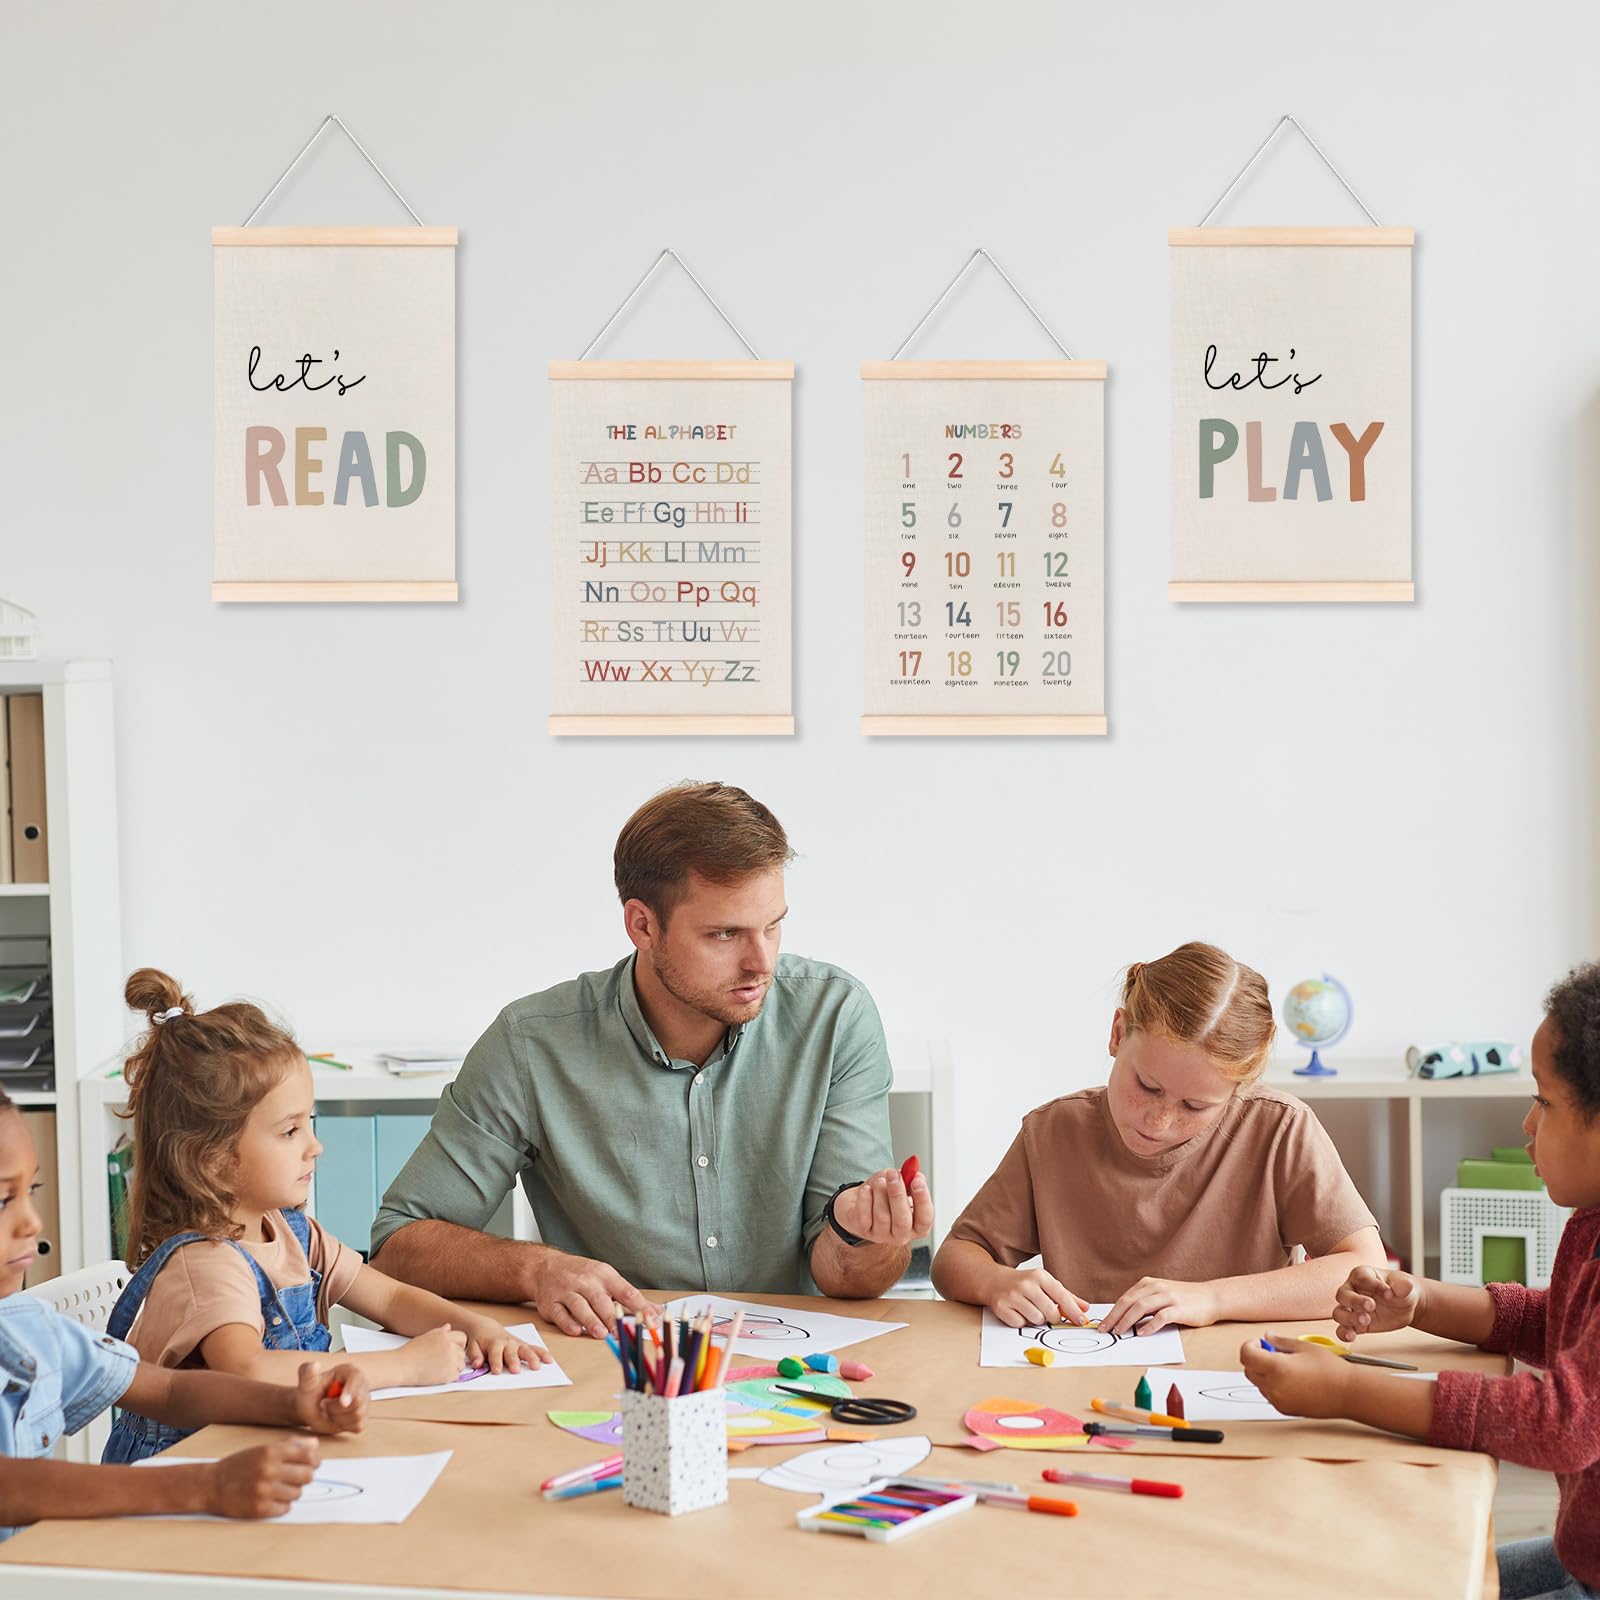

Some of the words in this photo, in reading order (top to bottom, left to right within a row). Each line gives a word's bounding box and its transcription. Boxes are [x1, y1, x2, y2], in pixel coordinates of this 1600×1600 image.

[248, 345, 366, 396] let's
[1204, 344, 1322, 395] let's
[606, 425, 637, 440] THE
[644, 425, 737, 440] ALPHABET
[945, 423, 1023, 439] NUMBERS
[245, 425, 427, 508] READ
[584, 462, 618, 483] Aa
[629, 462, 662, 483] Bb
[672, 462, 706, 483] Cc
[716, 462, 750, 483] Dd
[902, 453, 910, 479] 1
[948, 453, 963, 479] 2
[998, 453, 1014, 479] 3
[1049, 453, 1066, 479] 4
[1199, 418, 1385, 502] PLAY
[584, 502, 614, 523] Ee
[623, 502, 646, 523] Ff
[654, 501, 686, 528] Gg
[695, 502, 726, 523] Hh
[736, 502, 747, 523] Ii
[902, 502, 917, 528] 5
[947, 502, 962, 528] 6
[998, 502, 1013, 528] 7
[1051, 502, 1067, 528] 8
[1048, 531, 1068, 539] eight
[585, 541, 608, 568] Jj
[619, 541, 653, 562] Kk
[664, 541, 686, 562] Ll
[699, 541, 746, 562] Mm
[901, 552, 916, 577] 9
[944, 552, 971, 577] 10
[997, 552, 1016, 577] 11
[1043, 552, 1069, 577] 12
[586, 581, 619, 602] Nn
[630, 581, 667, 602] Oo
[677, 581, 710, 607] Pp
[720, 581, 756, 607] Qq
[897, 601, 922, 627] 13
[945, 601, 972, 627] 14
[996, 601, 1021, 627] 15
[1043, 601, 1068, 627] 16
[584, 621, 609, 642] Rr
[617, 621, 644, 642] Ss
[652, 621, 674, 642] Tt
[683, 621, 711, 642] Uu
[720, 621, 748, 642] Vv
[584, 660, 631, 681] Ww
[640, 660, 673, 681] Xx
[682, 660, 715, 687] Yy
[724, 660, 756, 681] Zz
[899, 651, 922, 677] 17
[947, 651, 972, 677] 18
[996, 651, 1020, 677] 19
[1042, 651, 1072, 677] 20
[1042, 678, 1072, 687] twenty
